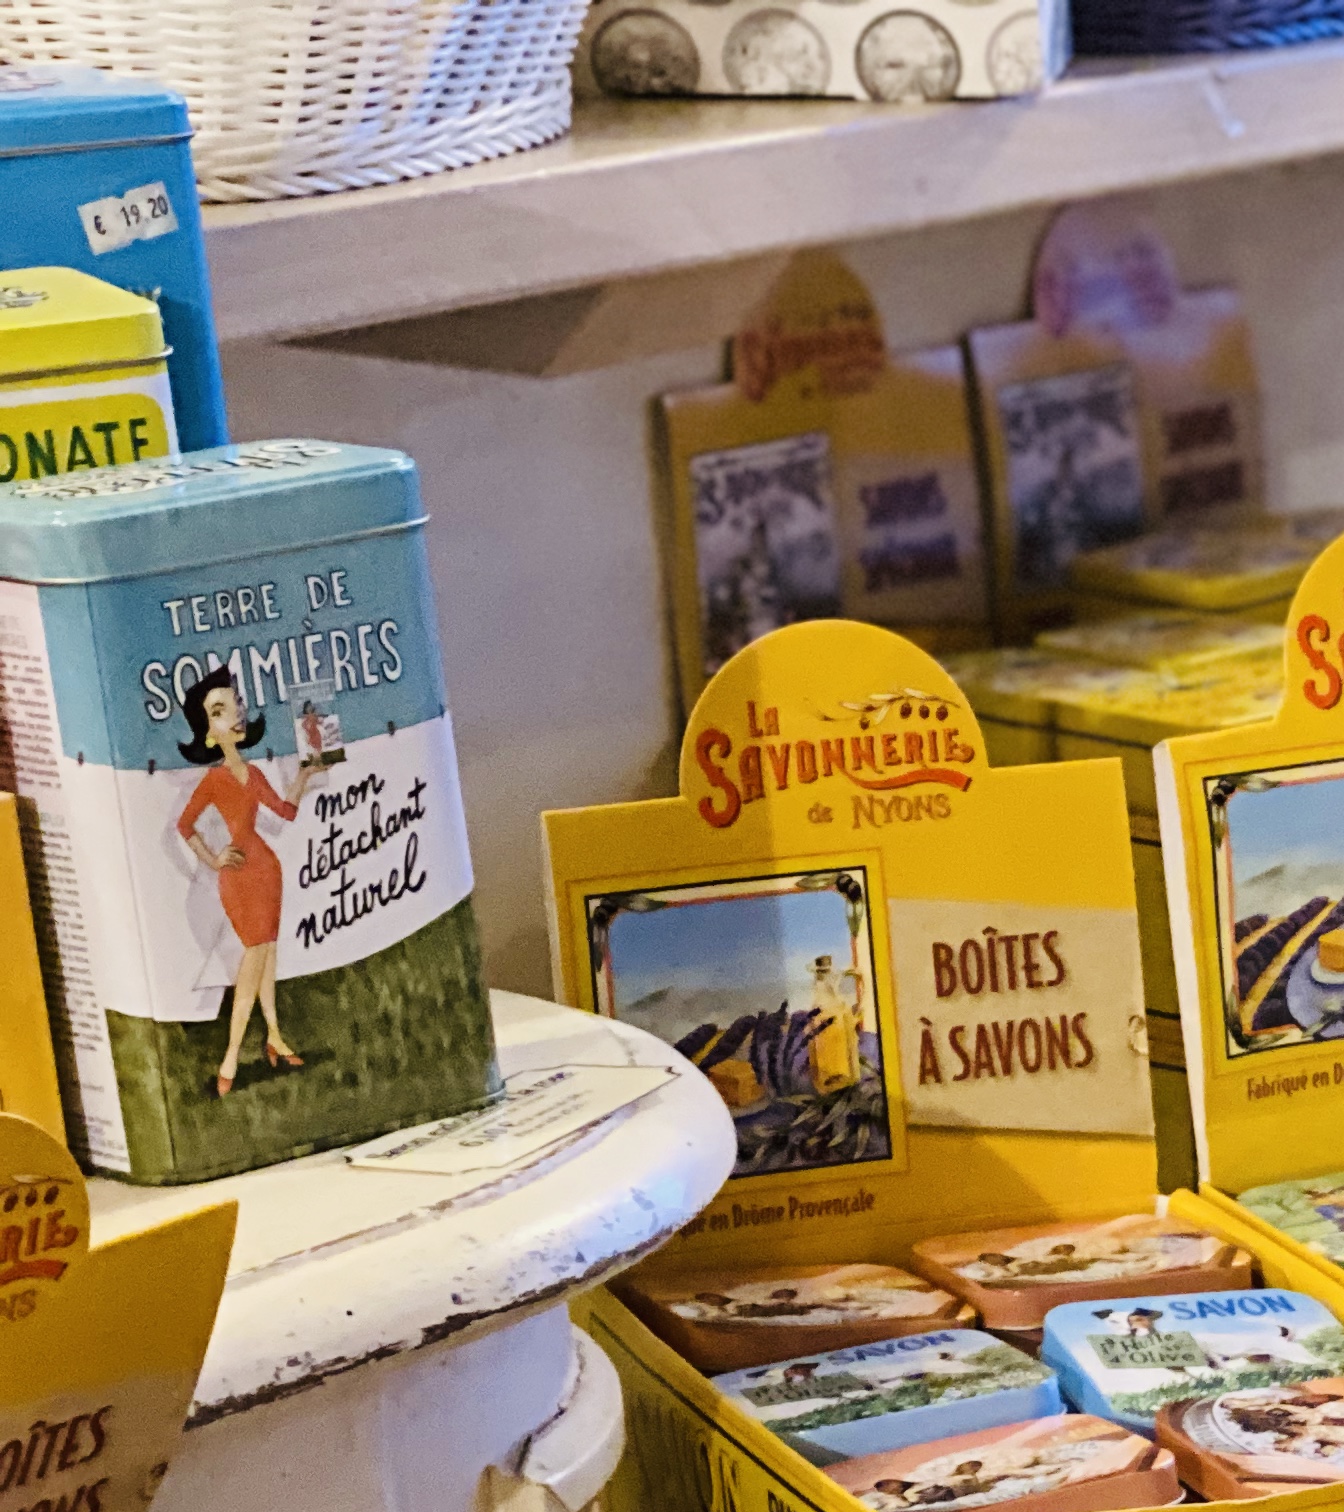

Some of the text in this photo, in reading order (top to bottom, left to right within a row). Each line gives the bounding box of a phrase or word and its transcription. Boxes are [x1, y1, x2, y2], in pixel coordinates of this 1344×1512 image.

[120, 194, 169, 228] 19.20
[163, 569, 353, 637] TERRE DE
[314, 772, 386, 824] mon
[299, 777, 428, 890] détachant
[295, 832, 428, 949] naturel
[932, 926, 1067, 999] BOÎTES
[918, 1011, 1095, 1087] À SAVONS
[1312, 1067, 1331, 1088] en
[1167, 1293, 1295, 1321] SAVON
